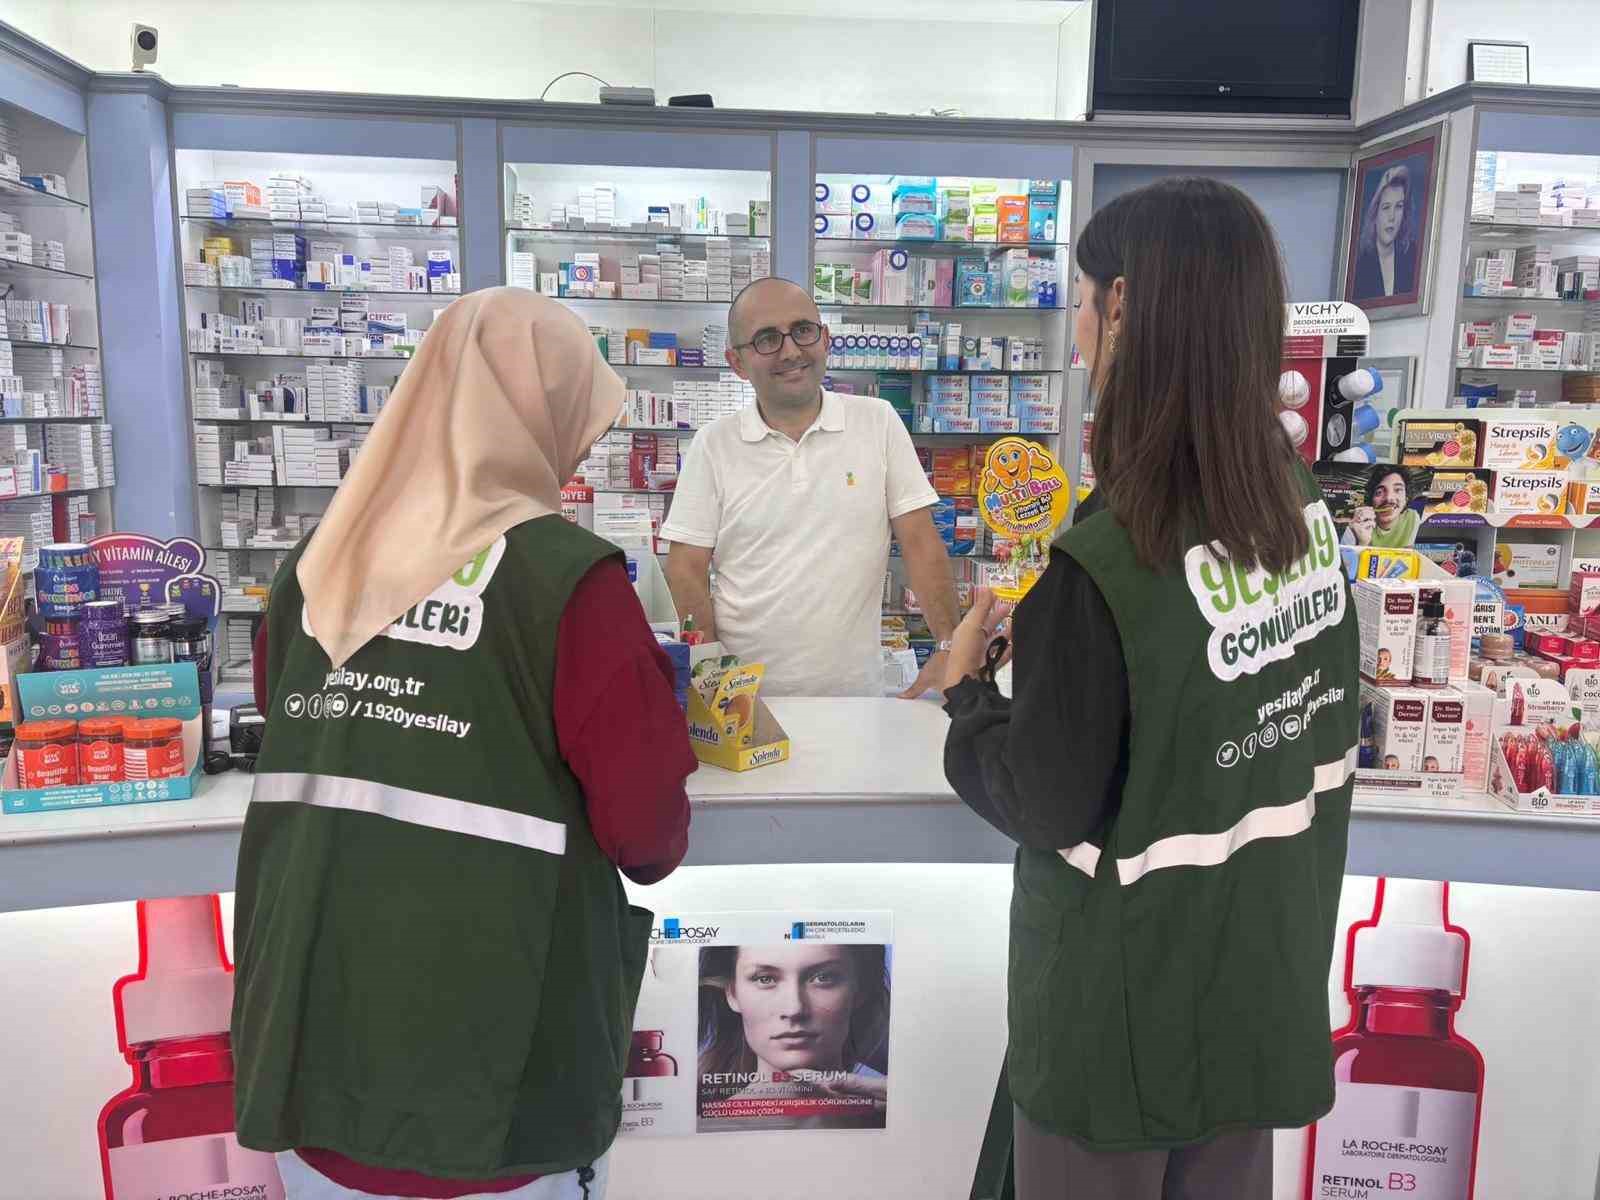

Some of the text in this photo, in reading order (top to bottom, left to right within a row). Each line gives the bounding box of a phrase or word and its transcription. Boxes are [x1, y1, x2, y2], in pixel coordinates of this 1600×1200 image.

[1294, 304, 1343, 315] VICHY
[1491, 426, 1551, 440] Strepsils
[1502, 476, 1563, 490] Strepsils
[560, 490, 586, 500] DİYE!
[103, 544, 154, 562] VİTAMİN
[322, 668, 425, 697] yesilay.org.tr
[750, 747, 781, 765] Splenda
[701, 1072, 769, 1085] RETINOL
[792, 1069, 848, 1082] SERUM
[728, 1108, 756, 1116] UZMAN
[1342, 1138, 1449, 1156] LA ROCHE-POSAY
[1322, 1172, 1417, 1192] RETINOL B3
[1321, 1186, 1369, 1199] SERUM
